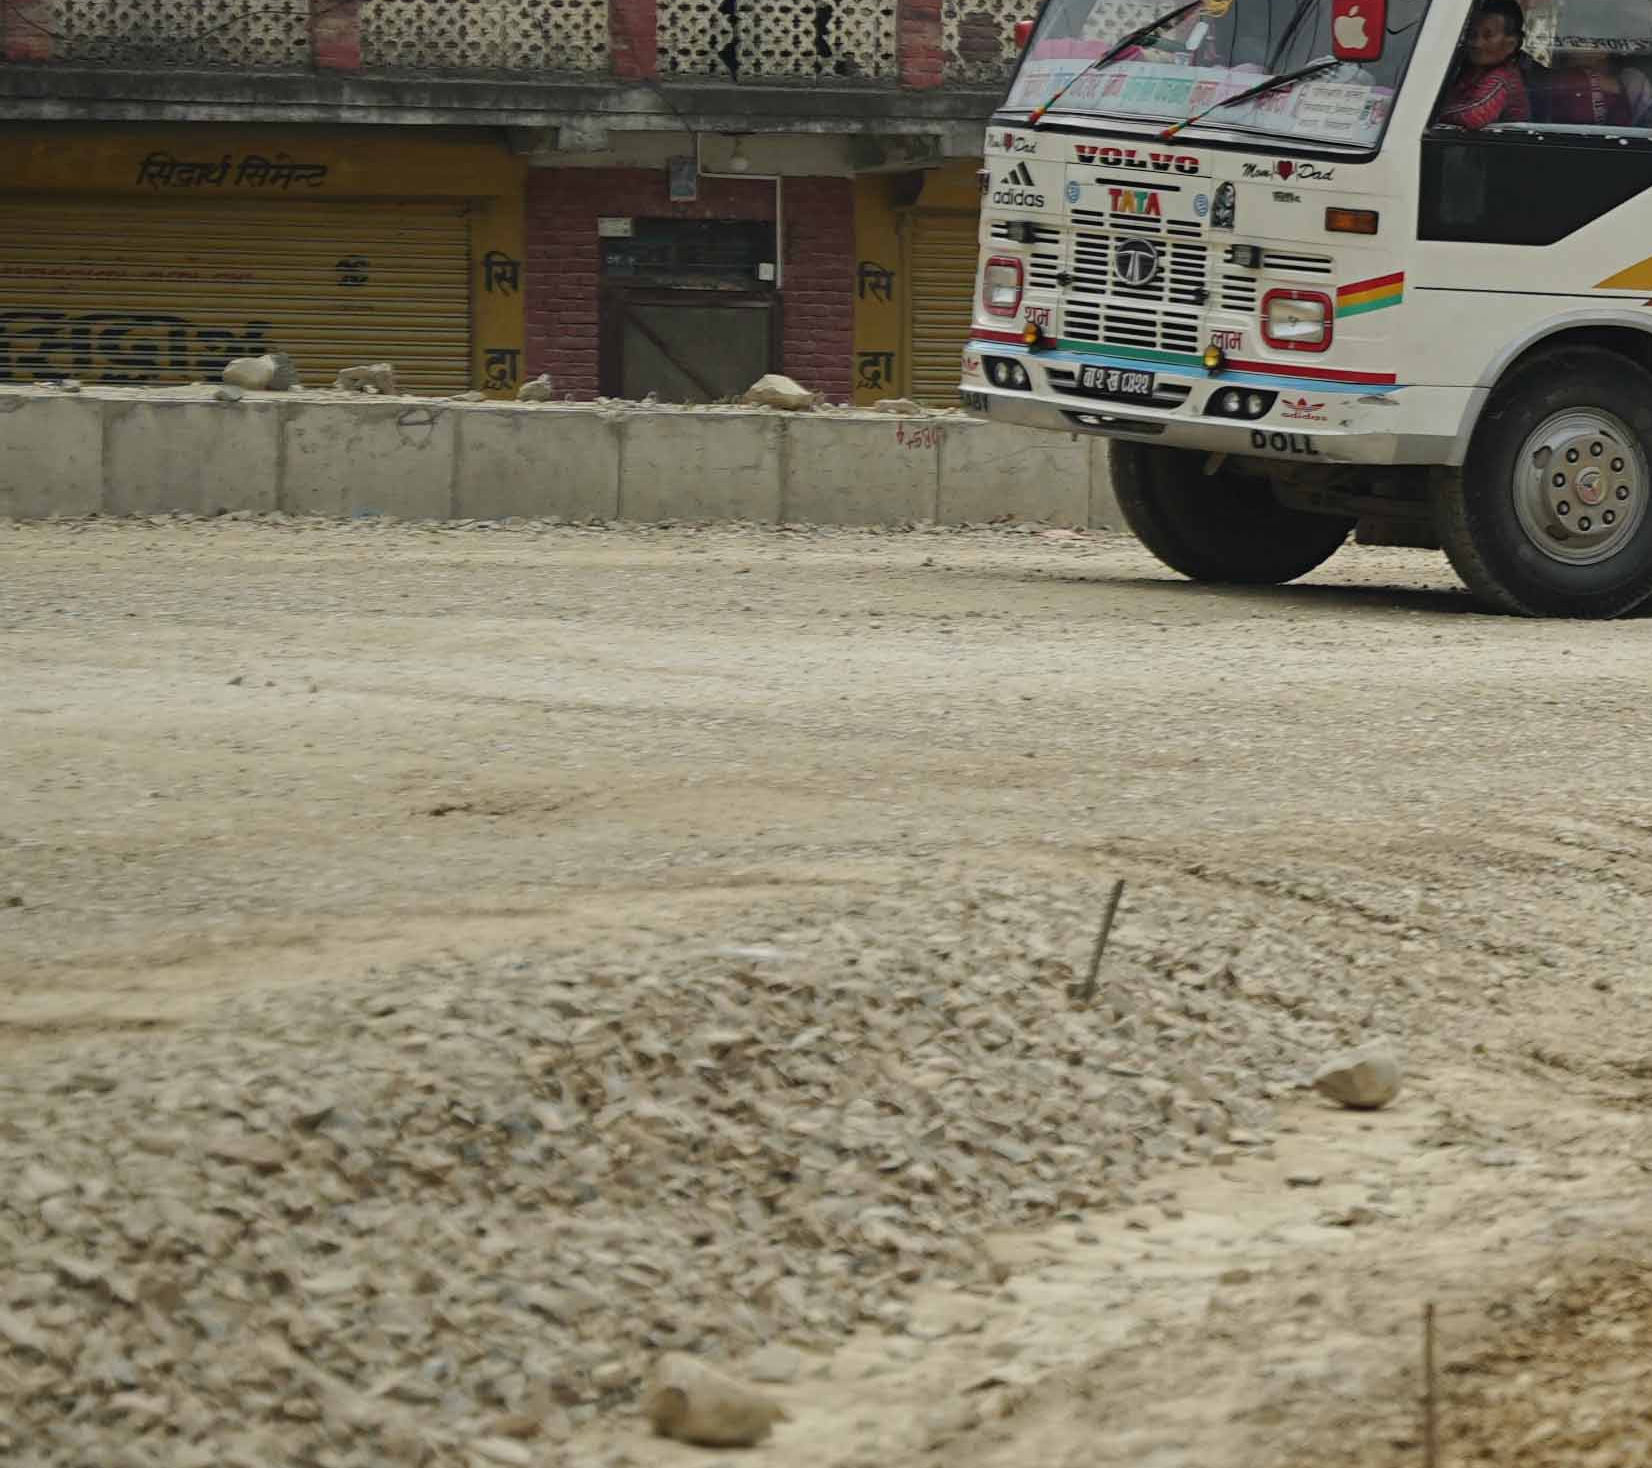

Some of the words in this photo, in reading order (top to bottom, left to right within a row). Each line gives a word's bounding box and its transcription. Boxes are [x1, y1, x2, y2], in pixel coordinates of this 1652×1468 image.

[1073, 143, 1201, 175] VOLVO
[1297, 163, 1335, 181] Dad
[993, 190, 1046, 209] adidas
[1108, 188, 1162, 217] TATA
[1249, 429, 1319, 456] DOLL
